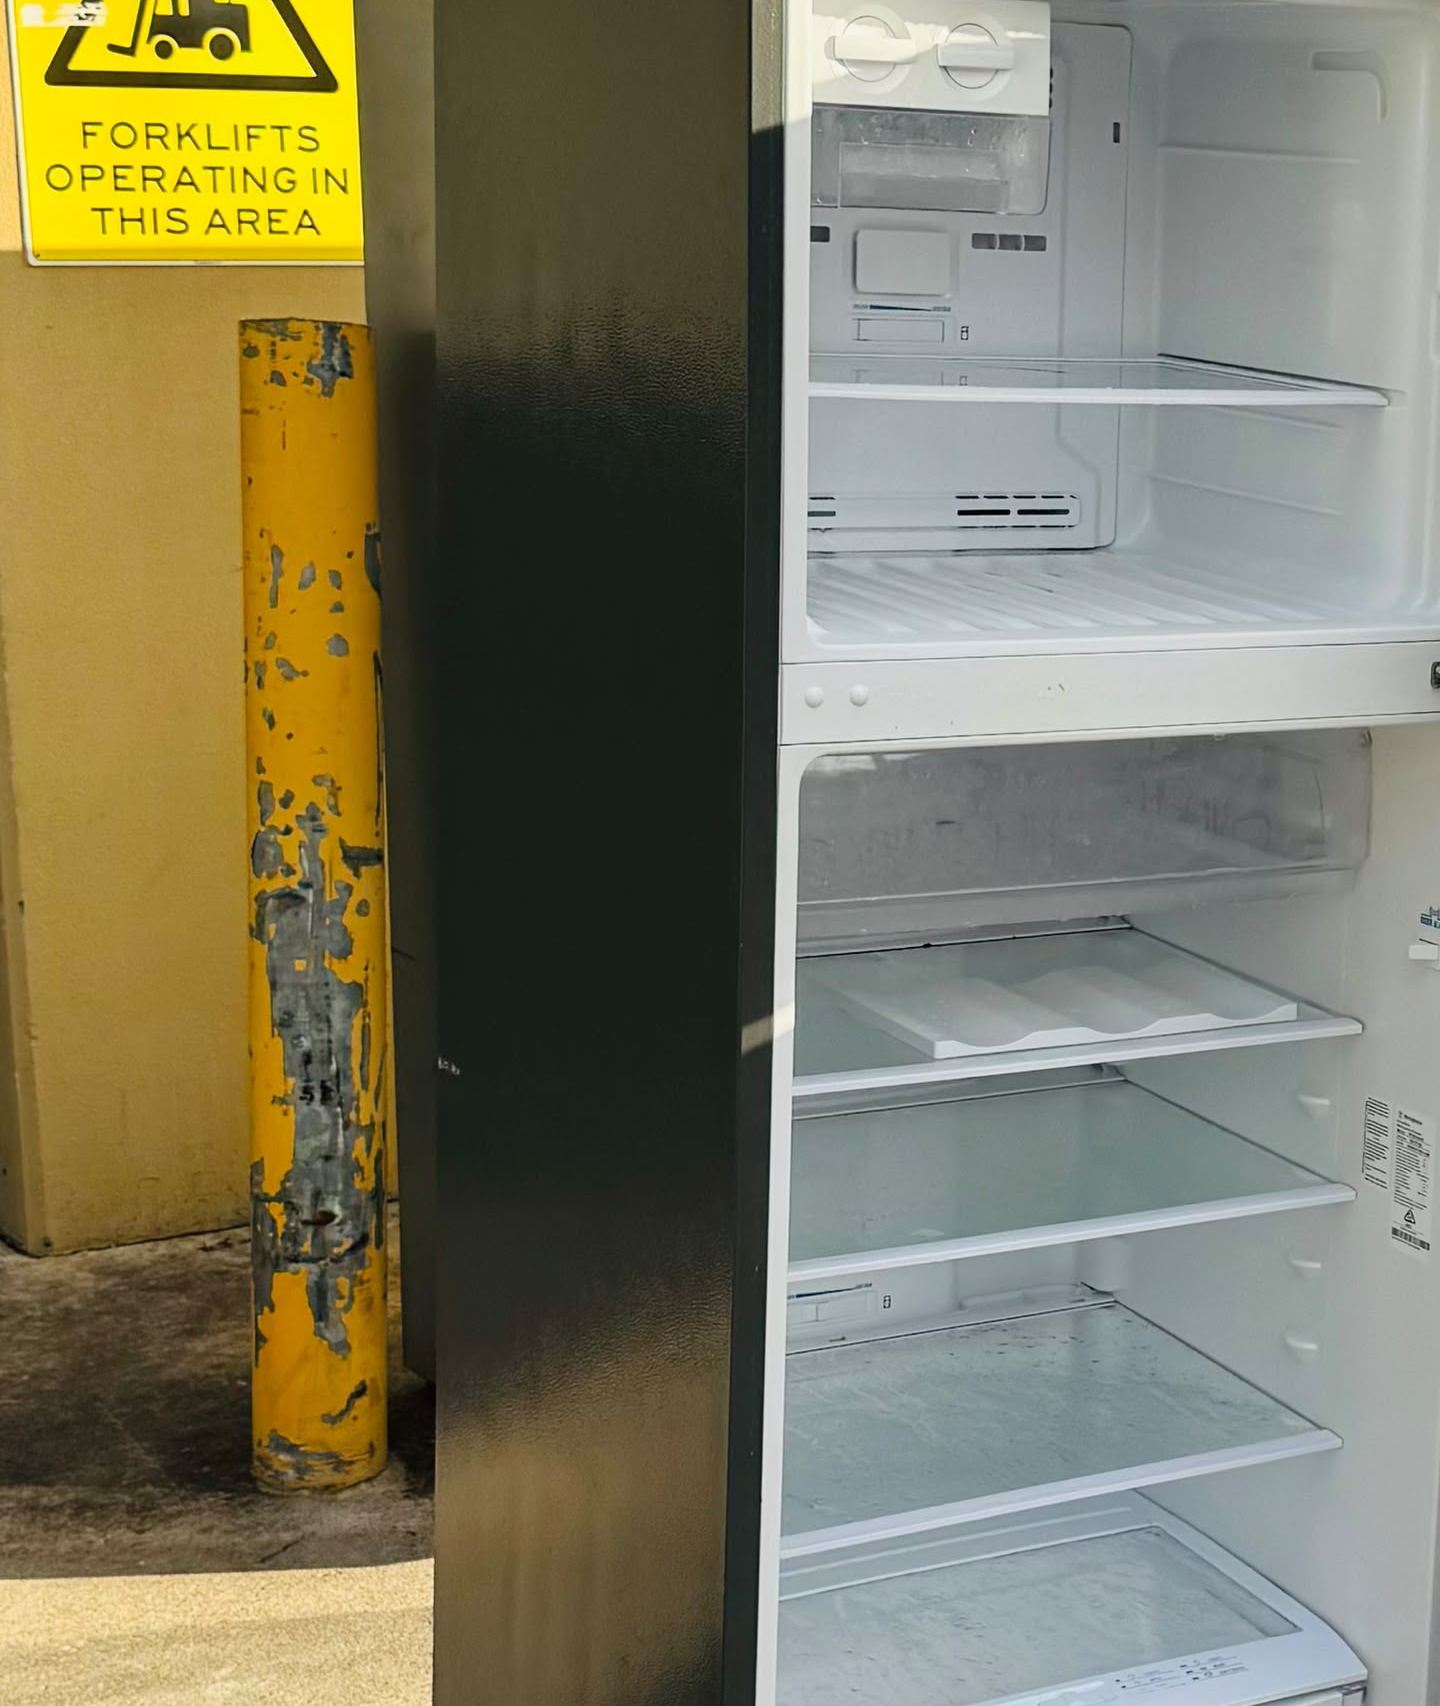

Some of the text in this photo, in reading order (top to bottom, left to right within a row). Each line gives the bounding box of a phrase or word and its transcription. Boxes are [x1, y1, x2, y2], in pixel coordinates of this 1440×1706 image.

[81, 121, 320, 153] FORKLIFTS
[45, 163, 349, 195] OPERATING IN
[91, 207, 322, 236] THIS AREA
